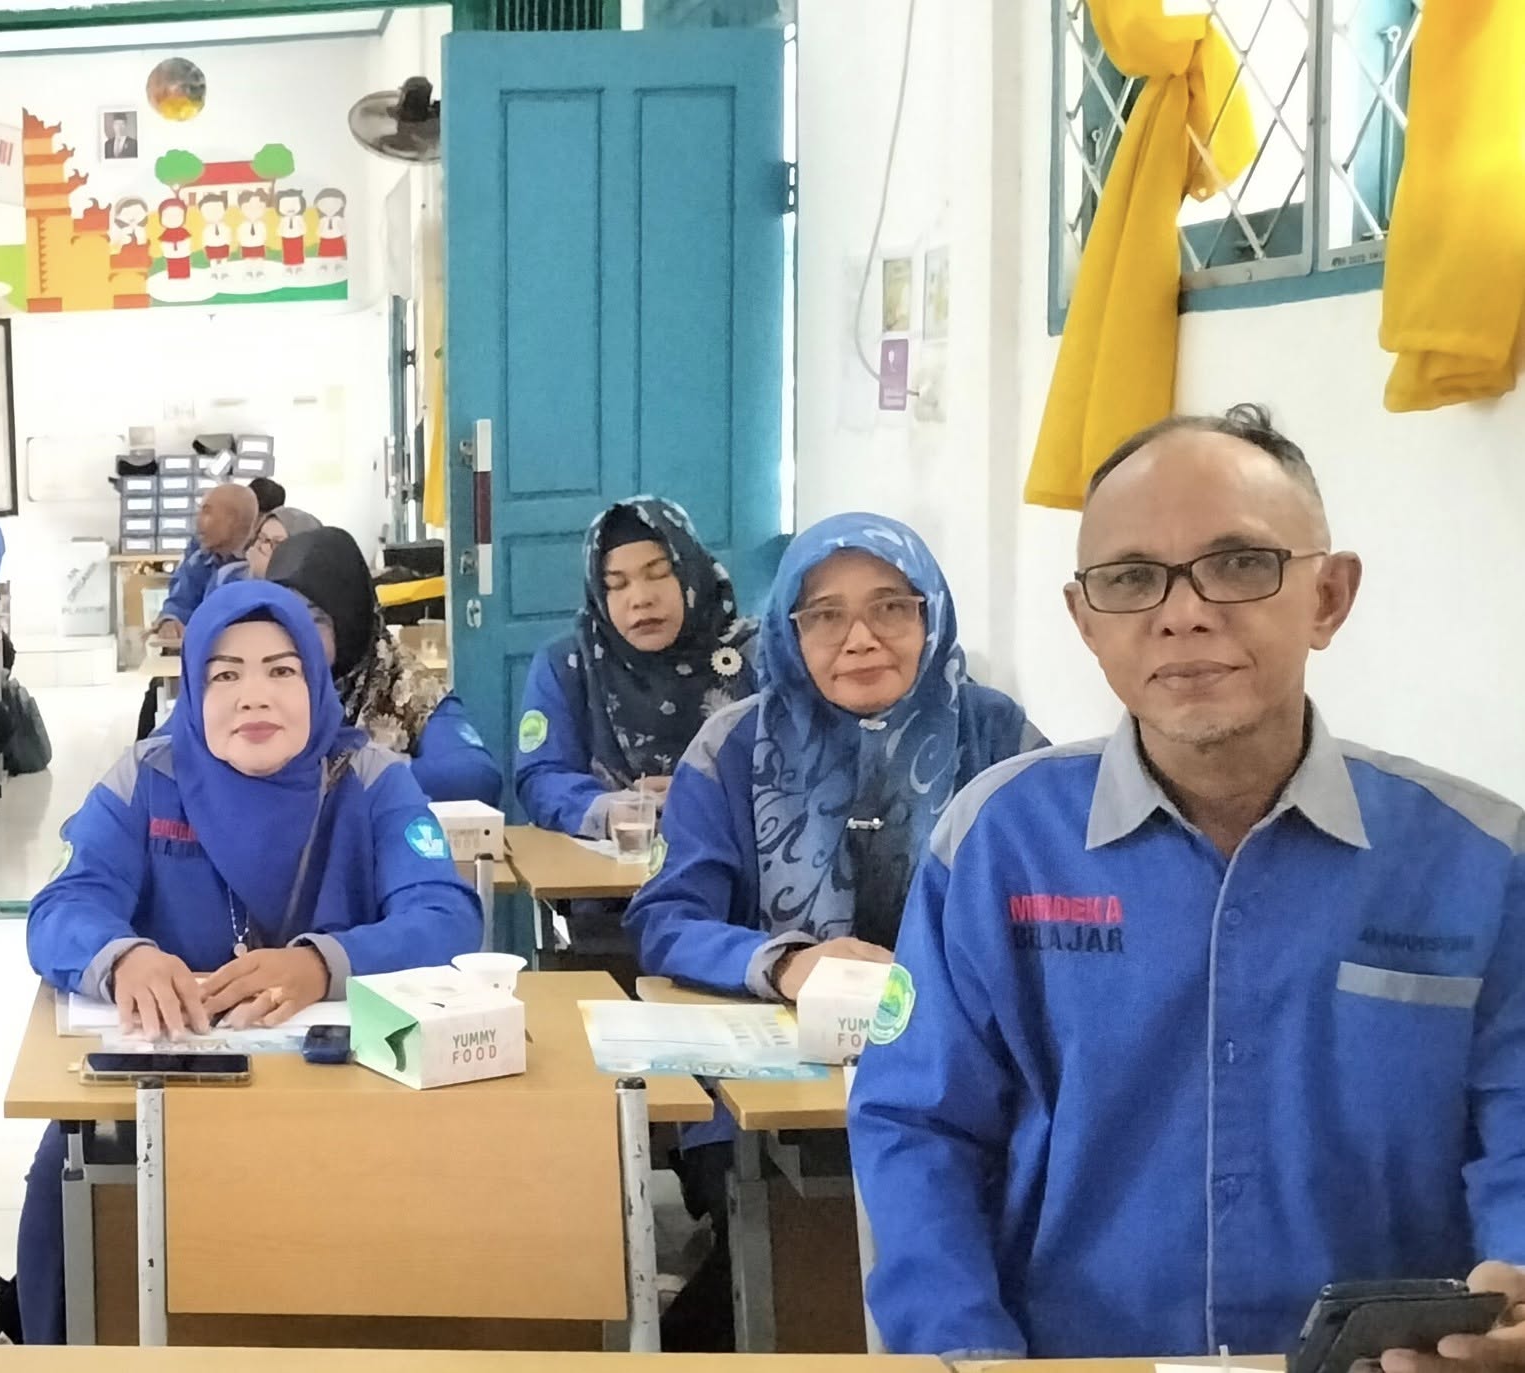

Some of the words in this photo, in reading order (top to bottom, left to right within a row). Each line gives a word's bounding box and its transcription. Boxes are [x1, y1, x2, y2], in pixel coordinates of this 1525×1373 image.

[837, 1017, 870, 1032] YUM
[452, 1029, 496, 1049] YUMMY
[837, 1033, 862, 1048] FO
[452, 1044, 497, 1065] FOOD
